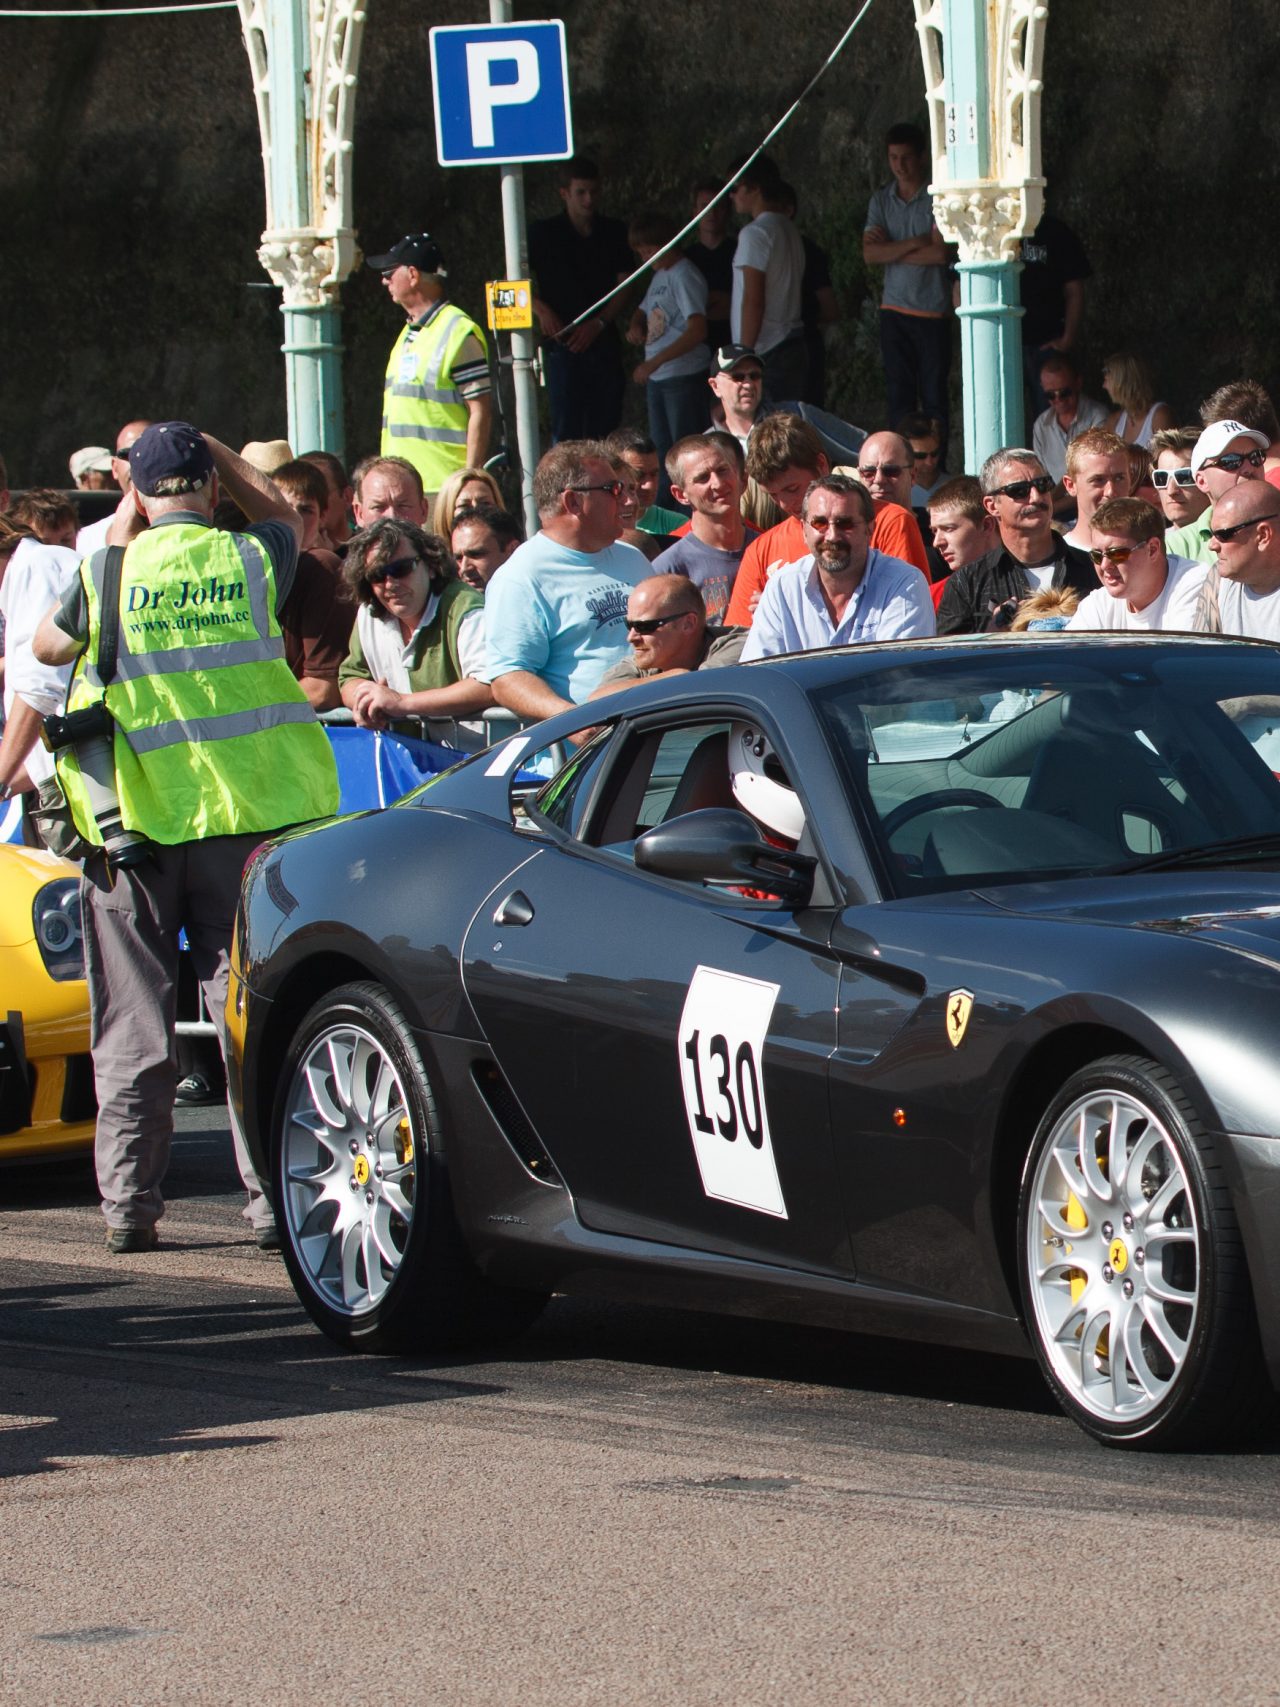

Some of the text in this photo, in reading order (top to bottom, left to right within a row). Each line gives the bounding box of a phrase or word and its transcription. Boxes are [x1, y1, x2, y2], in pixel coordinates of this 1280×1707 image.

[466, 40, 541, 149] P
[128, 577, 245, 612] Dr John
[130, 610, 250, 635] www.drjohn.cc
[685, 1028, 764, 1150] 130
